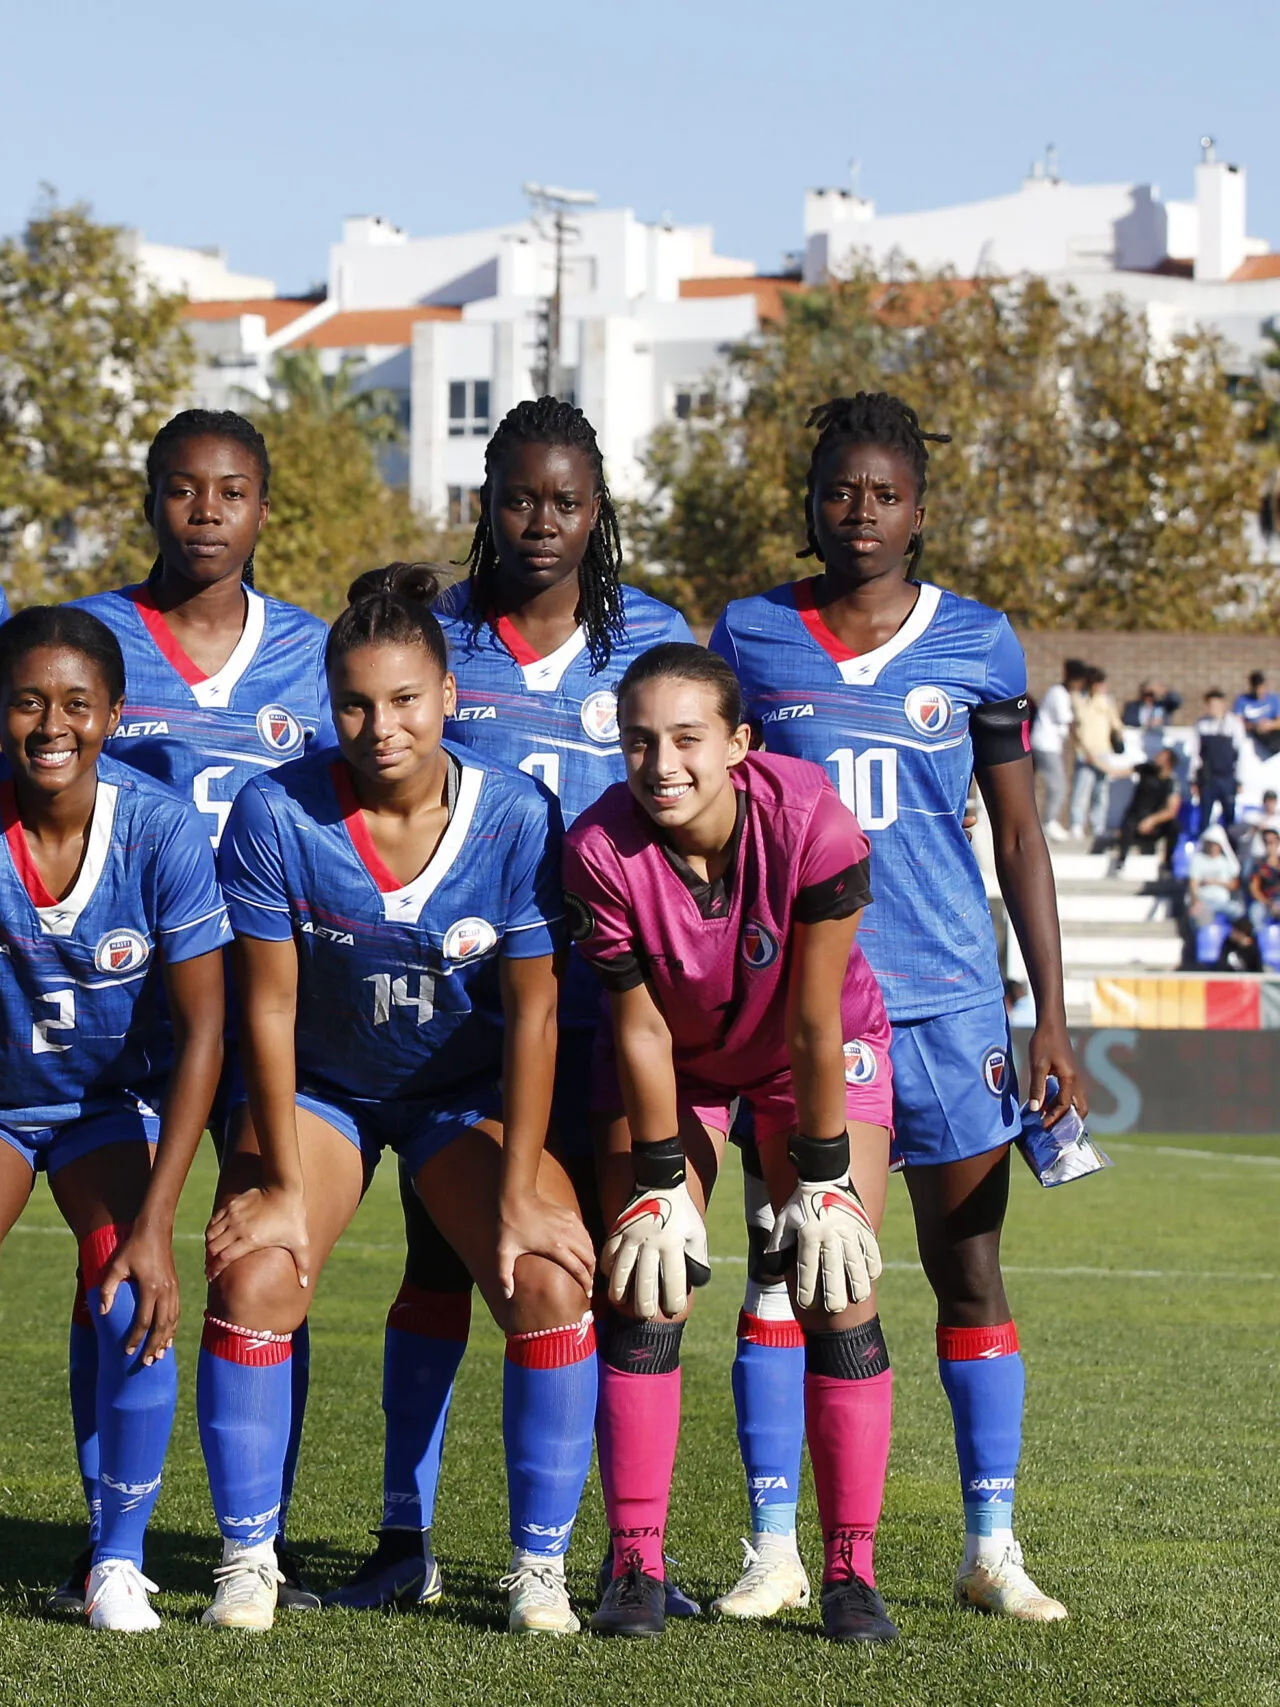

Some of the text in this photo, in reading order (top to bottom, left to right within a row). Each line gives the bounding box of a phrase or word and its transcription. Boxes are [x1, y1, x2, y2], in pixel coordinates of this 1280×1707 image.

[104, 720, 169, 740] AETA
[825, 747, 898, 831] 10
[32, 989, 75, 1055] 2
[363, 972, 435, 1026] 14
[747, 1474, 788, 1489] AETA
